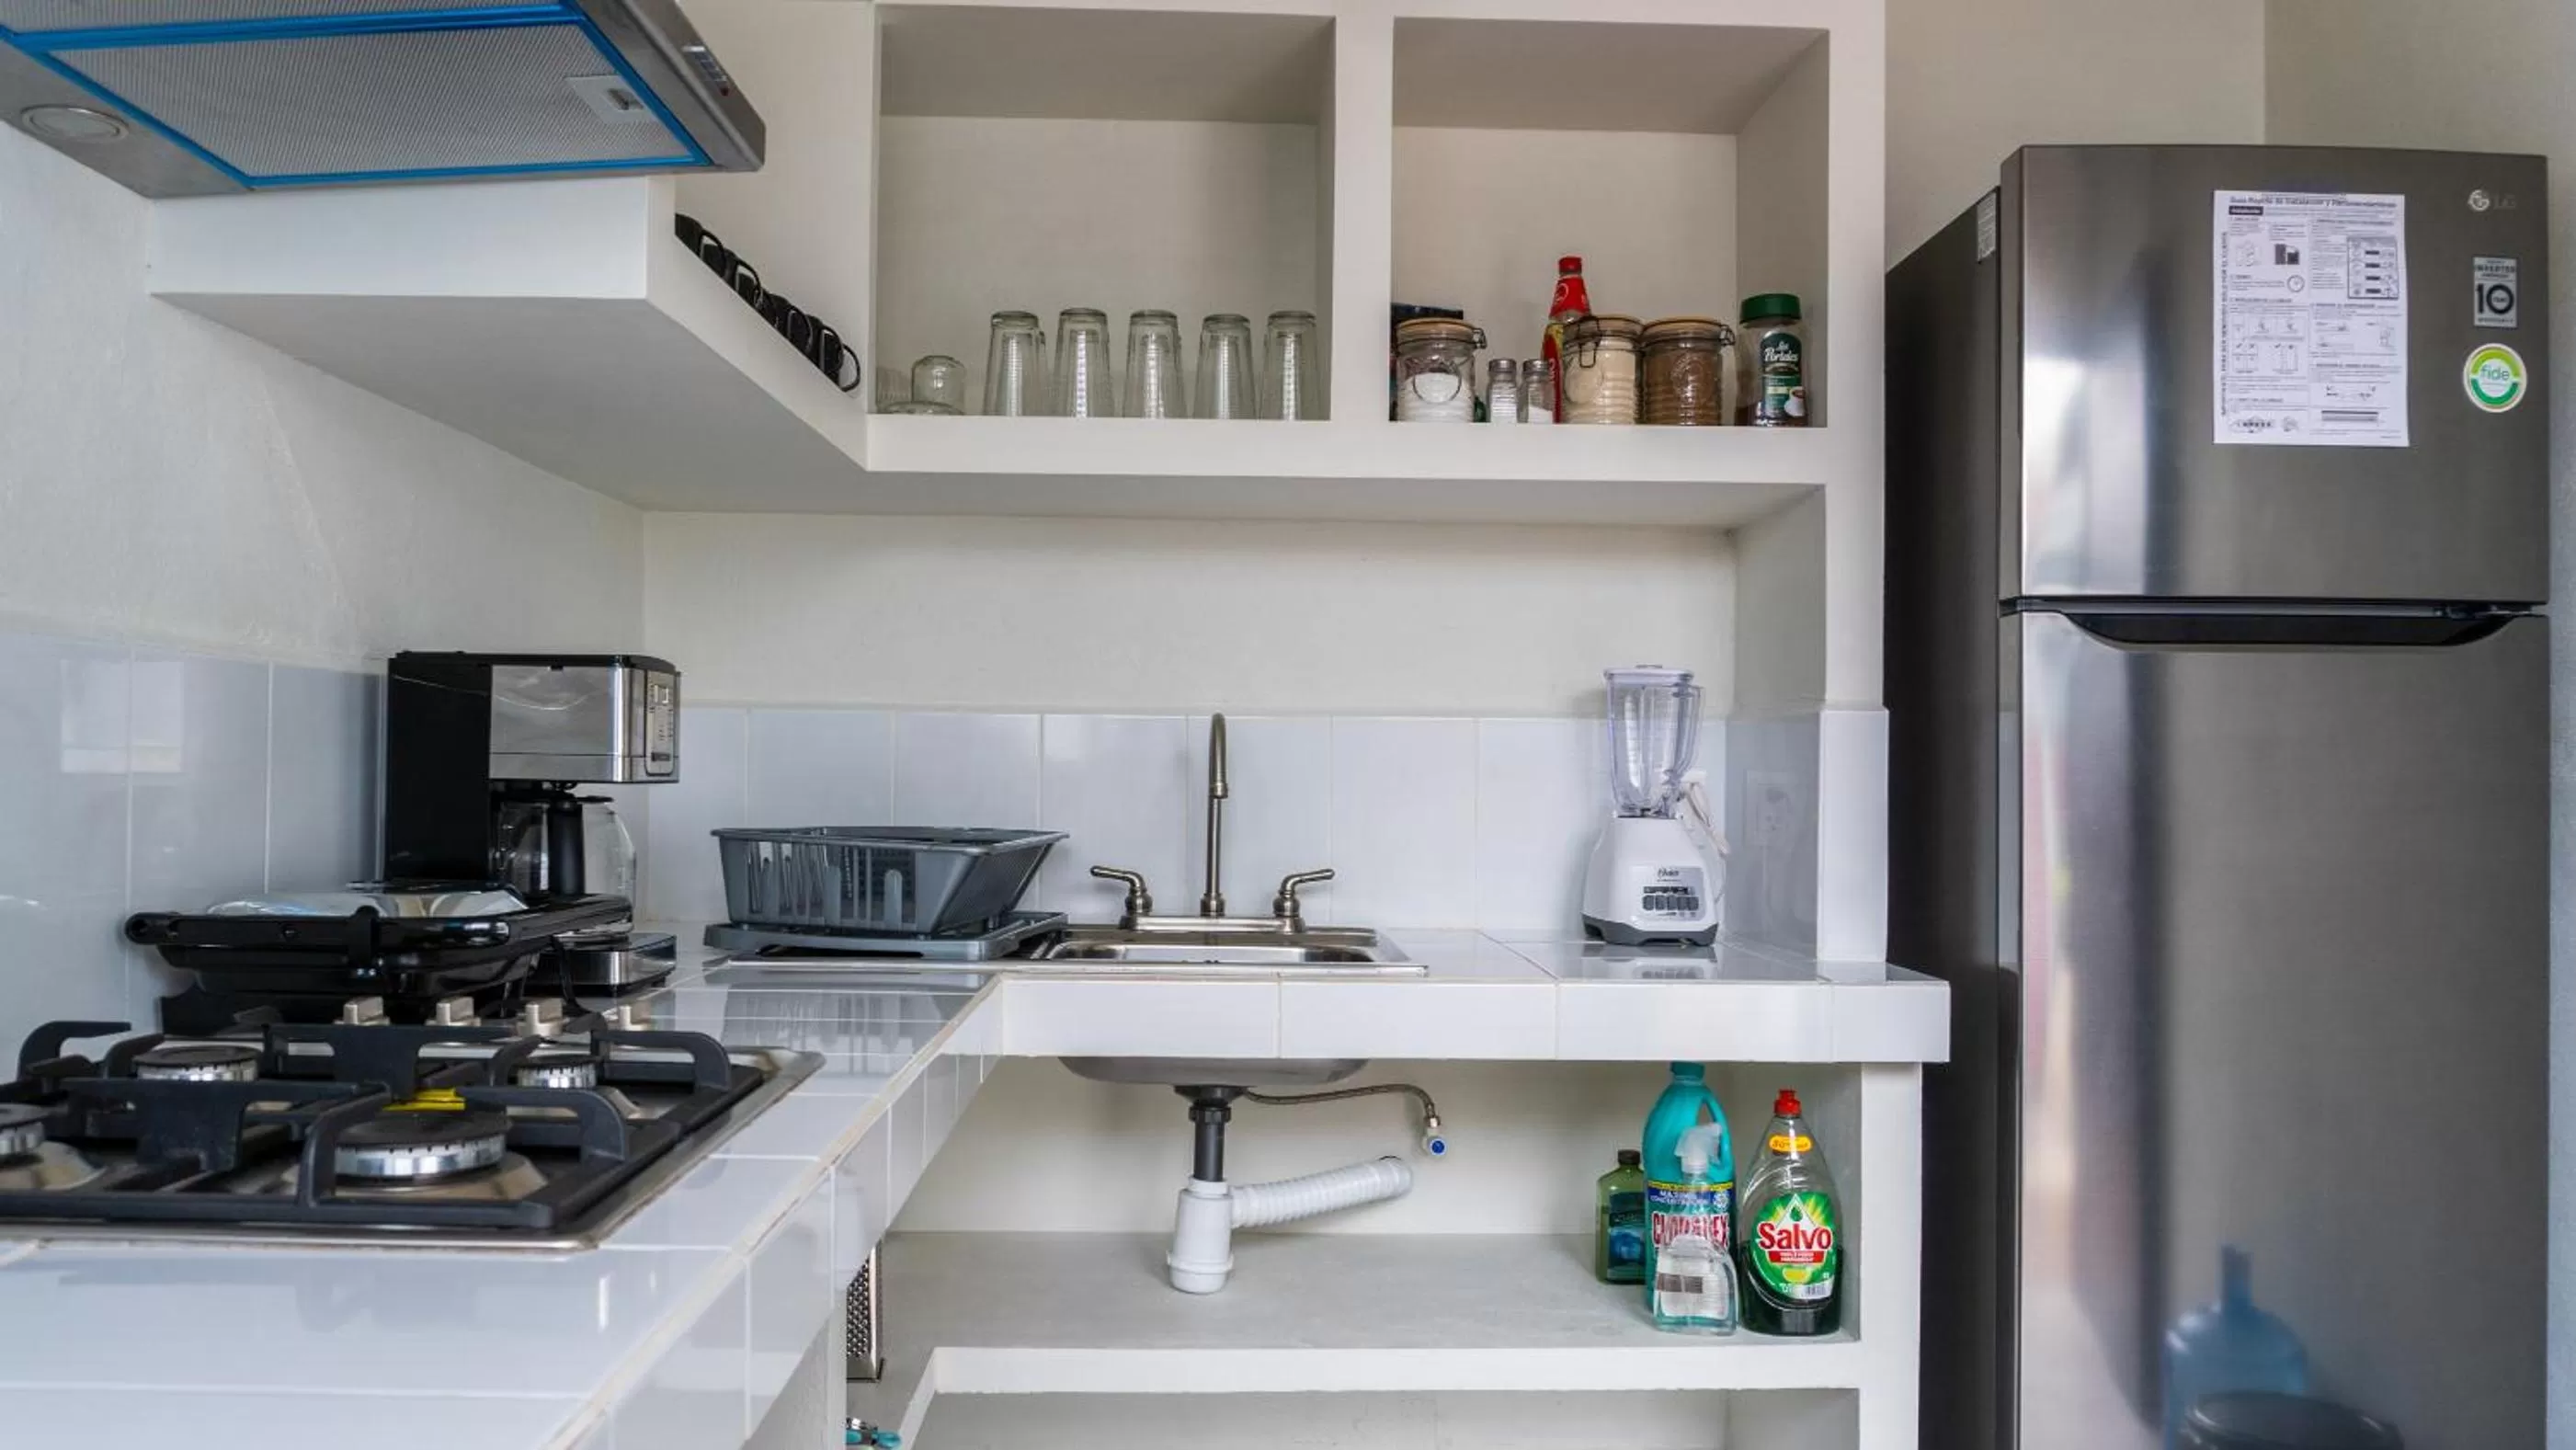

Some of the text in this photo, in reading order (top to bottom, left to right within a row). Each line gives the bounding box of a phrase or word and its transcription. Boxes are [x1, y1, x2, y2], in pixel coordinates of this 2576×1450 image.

[2477, 283, 2514, 314] 10
[2481, 364, 2510, 381] fide
[1758, 1221, 1832, 1250] Salvo
